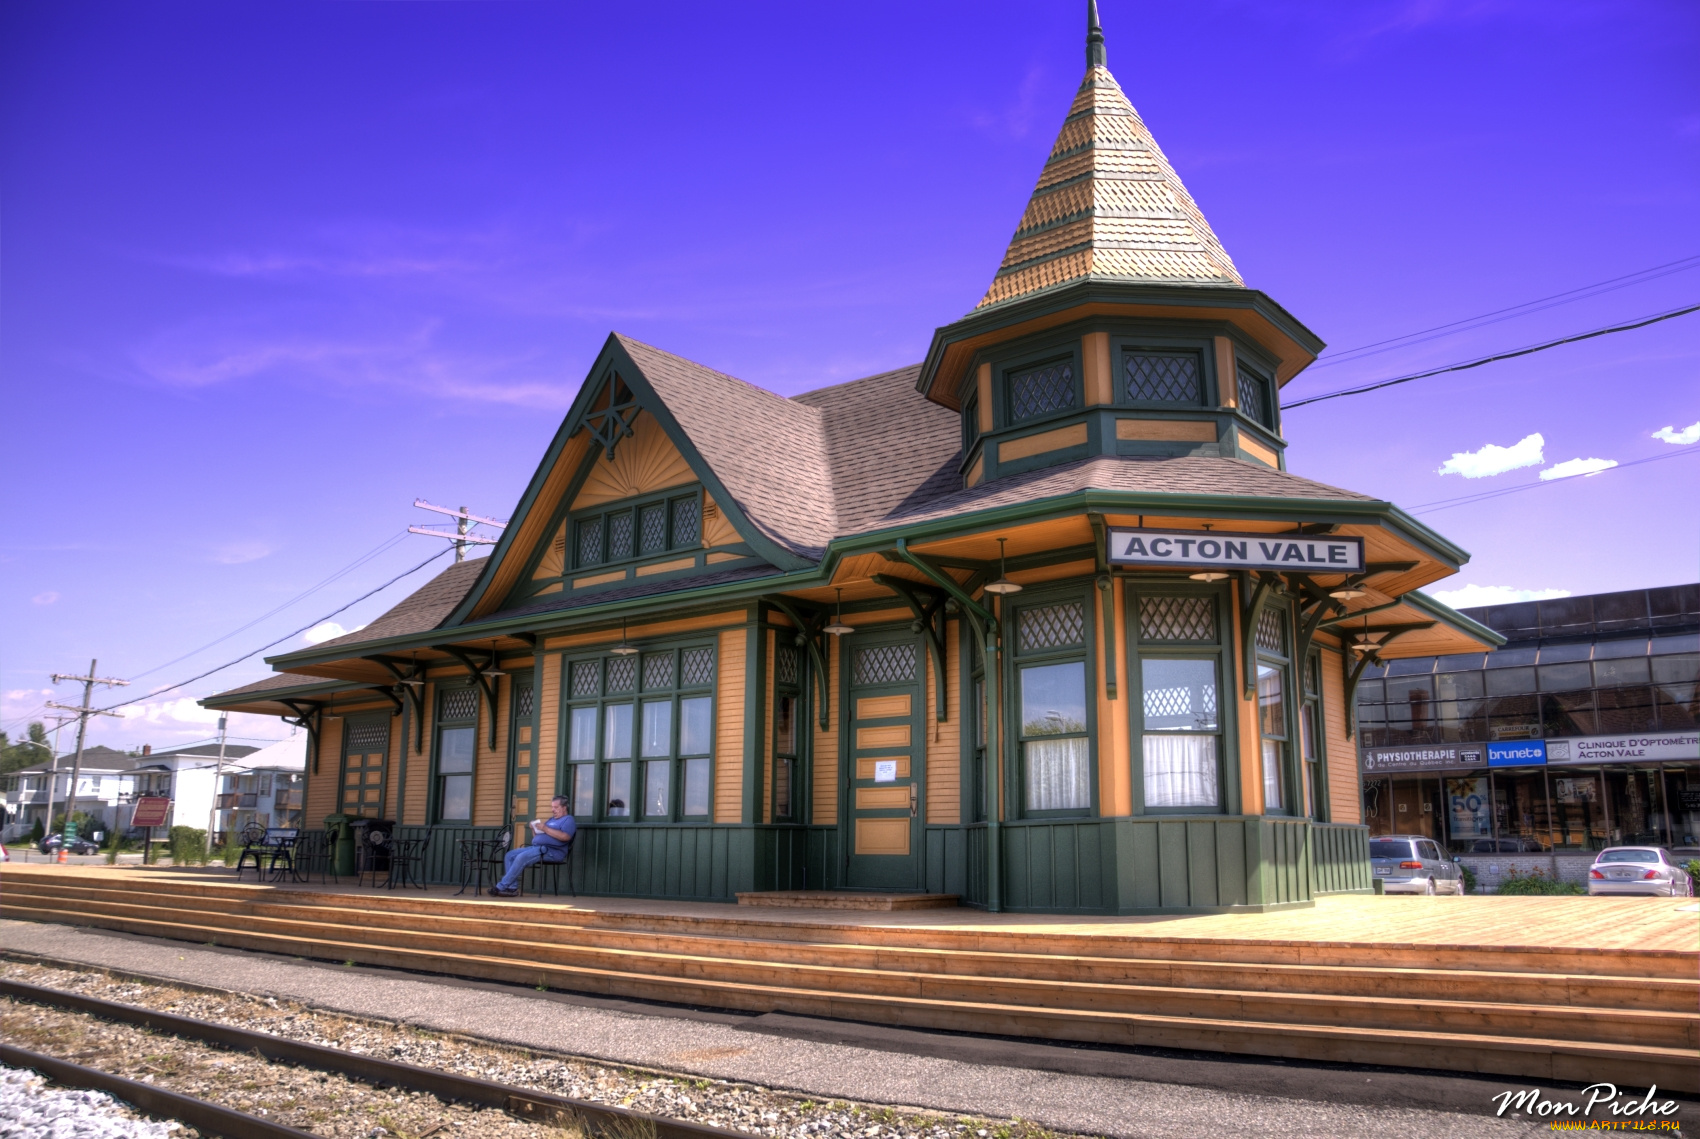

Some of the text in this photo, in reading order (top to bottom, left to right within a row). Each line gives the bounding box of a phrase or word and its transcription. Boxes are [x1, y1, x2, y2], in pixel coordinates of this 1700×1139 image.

[1124, 537, 1348, 564] ACTON VALE
[1578, 740, 1626, 750] CLINIQUE
[1489, 748, 1534, 760] brunet
[1579, 749, 1646, 759] ACTON VALE
